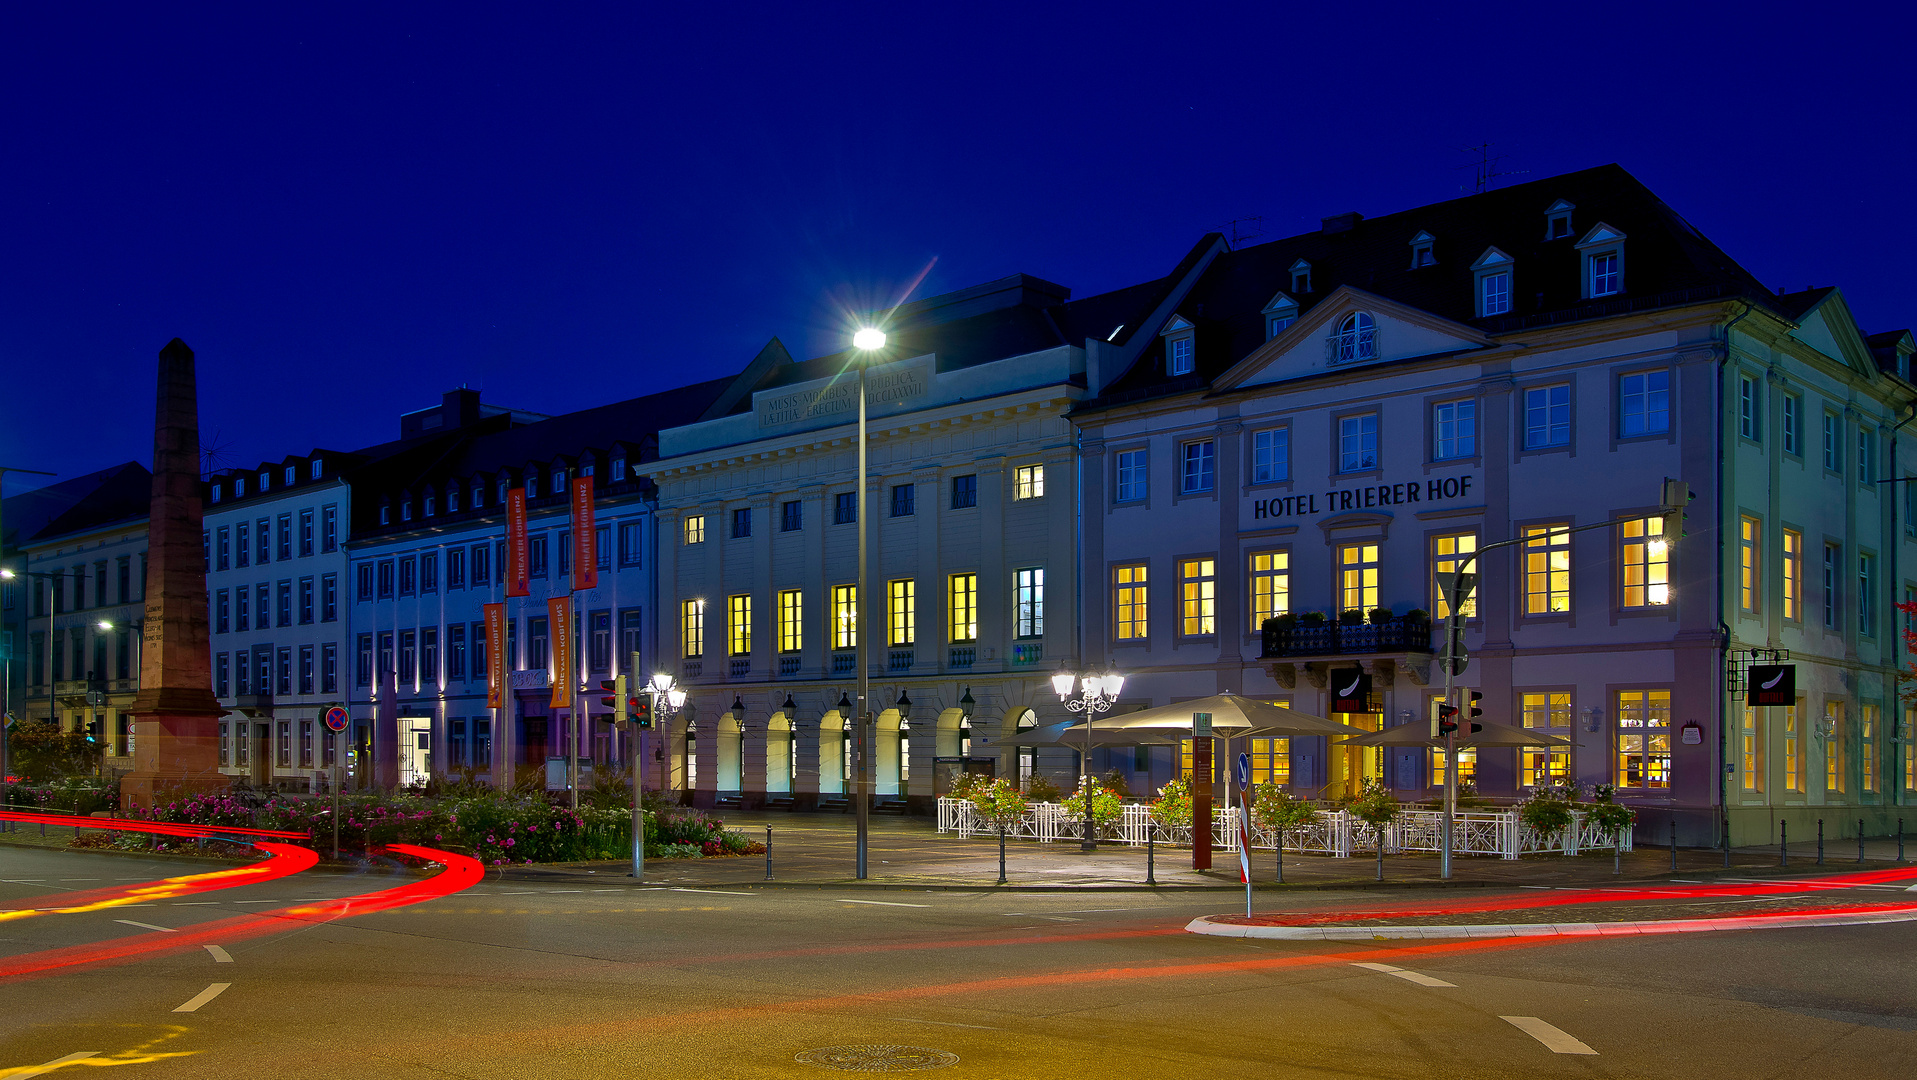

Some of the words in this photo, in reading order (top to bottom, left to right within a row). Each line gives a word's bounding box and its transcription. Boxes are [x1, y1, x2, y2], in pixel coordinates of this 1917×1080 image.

[768, 395, 798, 412] MUSIS
[803, 384, 848, 404] MORIBUS
[807, 397, 851, 417] ERECTUM
[514, 494, 523, 538] KOBLENZ
[580, 483, 590, 528] KOBLENZ
[1254, 494, 1320, 519] HOTEL
[1325, 481, 1421, 511] TRIERER
[1427, 475, 1472, 501] HOF
[517, 539, 525, 580] THEATER
[580, 529, 590, 573] THEATER
